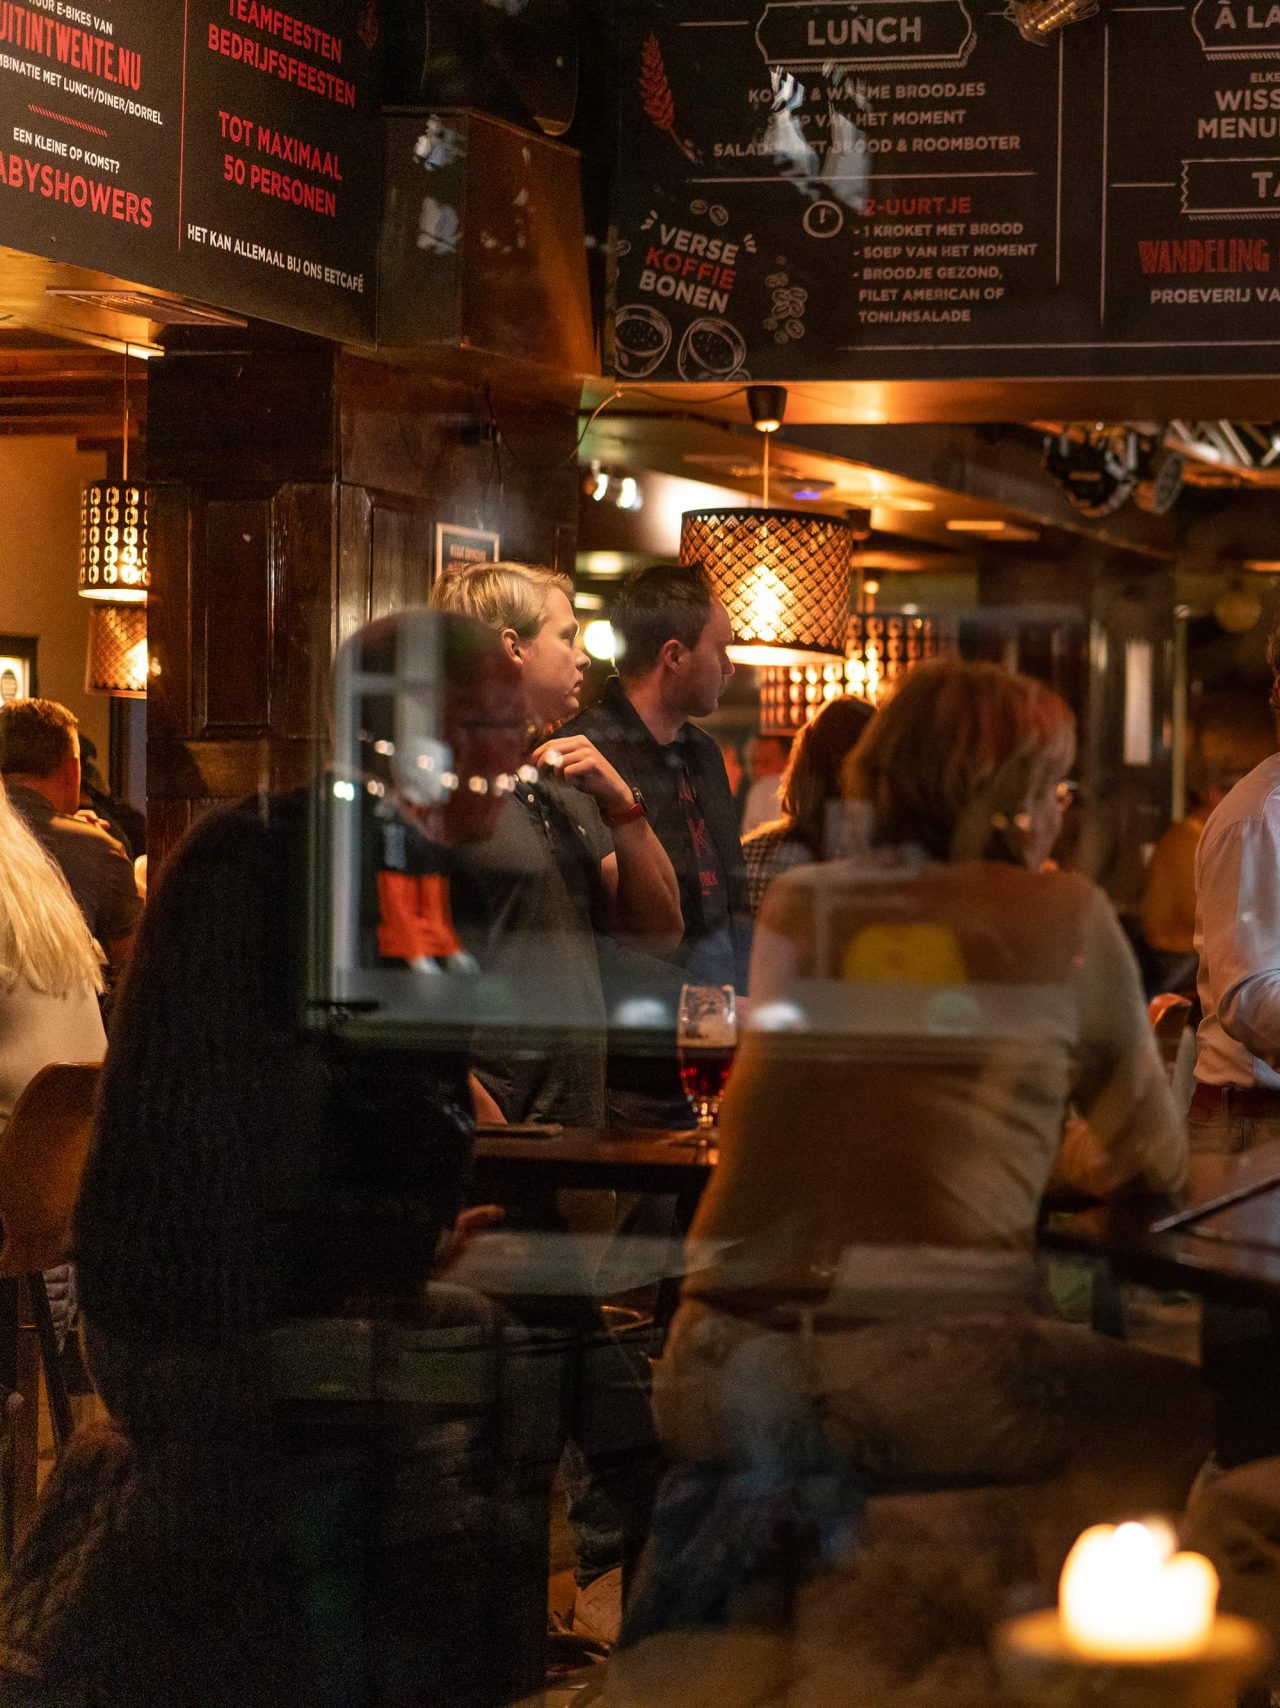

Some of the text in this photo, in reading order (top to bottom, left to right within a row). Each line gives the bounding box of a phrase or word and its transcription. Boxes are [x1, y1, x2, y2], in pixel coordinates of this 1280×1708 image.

[56, 2, 91, 26] E-BIKES
[93, 16, 113, 35] VAN
[807, 16, 922, 46] LUNCH
[208, 23, 356, 108] BEDRIJFSFEESTEN
[43, 69, 61, 88] MET
[64, 78, 163, 125] LUNCH/DINER/BORREL
[895, 82, 986, 98] BROODJES
[856, 112, 889, 127] HET
[892, 110, 967, 126] MOMENT
[13, 127, 120, 174] EEN KLEINE OP KOMST?
[218, 111, 343, 181] TOT MAXIMAAL
[912, 135, 1021, 152] ROOMBOTER
[223, 154, 337, 217] 50 PERSONEN
[857, 196, 973, 217] 2-UURTJE
[660, 223, 739, 265] VERSE
[873, 224, 933, 237] KROKET
[936, 223, 965, 236] MET
[970, 222, 1024, 236] BROOD
[187, 224, 364, 293] HET KAN ALLEMAAL BIJ ONS EETCAFÉ
[863, 246, 901, 258] SOEP
[905, 245, 938, 258] VAN
[941, 245, 969, 257] HET
[973, 243, 1038, 256] MOMENT
[1137, 238, 1270, 274] WANDELING
[645, 245, 736, 289] KOFFIE
[862, 267, 933, 280] BROODJE
[936, 266, 1003, 280] GEZOND,
[639, 269, 729, 314] BONEN
[858, 287, 1005, 302] FILET AMERICAN OF
[1150, 287, 1251, 303] PROEVERIJ
[858, 310, 971, 323] TONIJNSALADE
